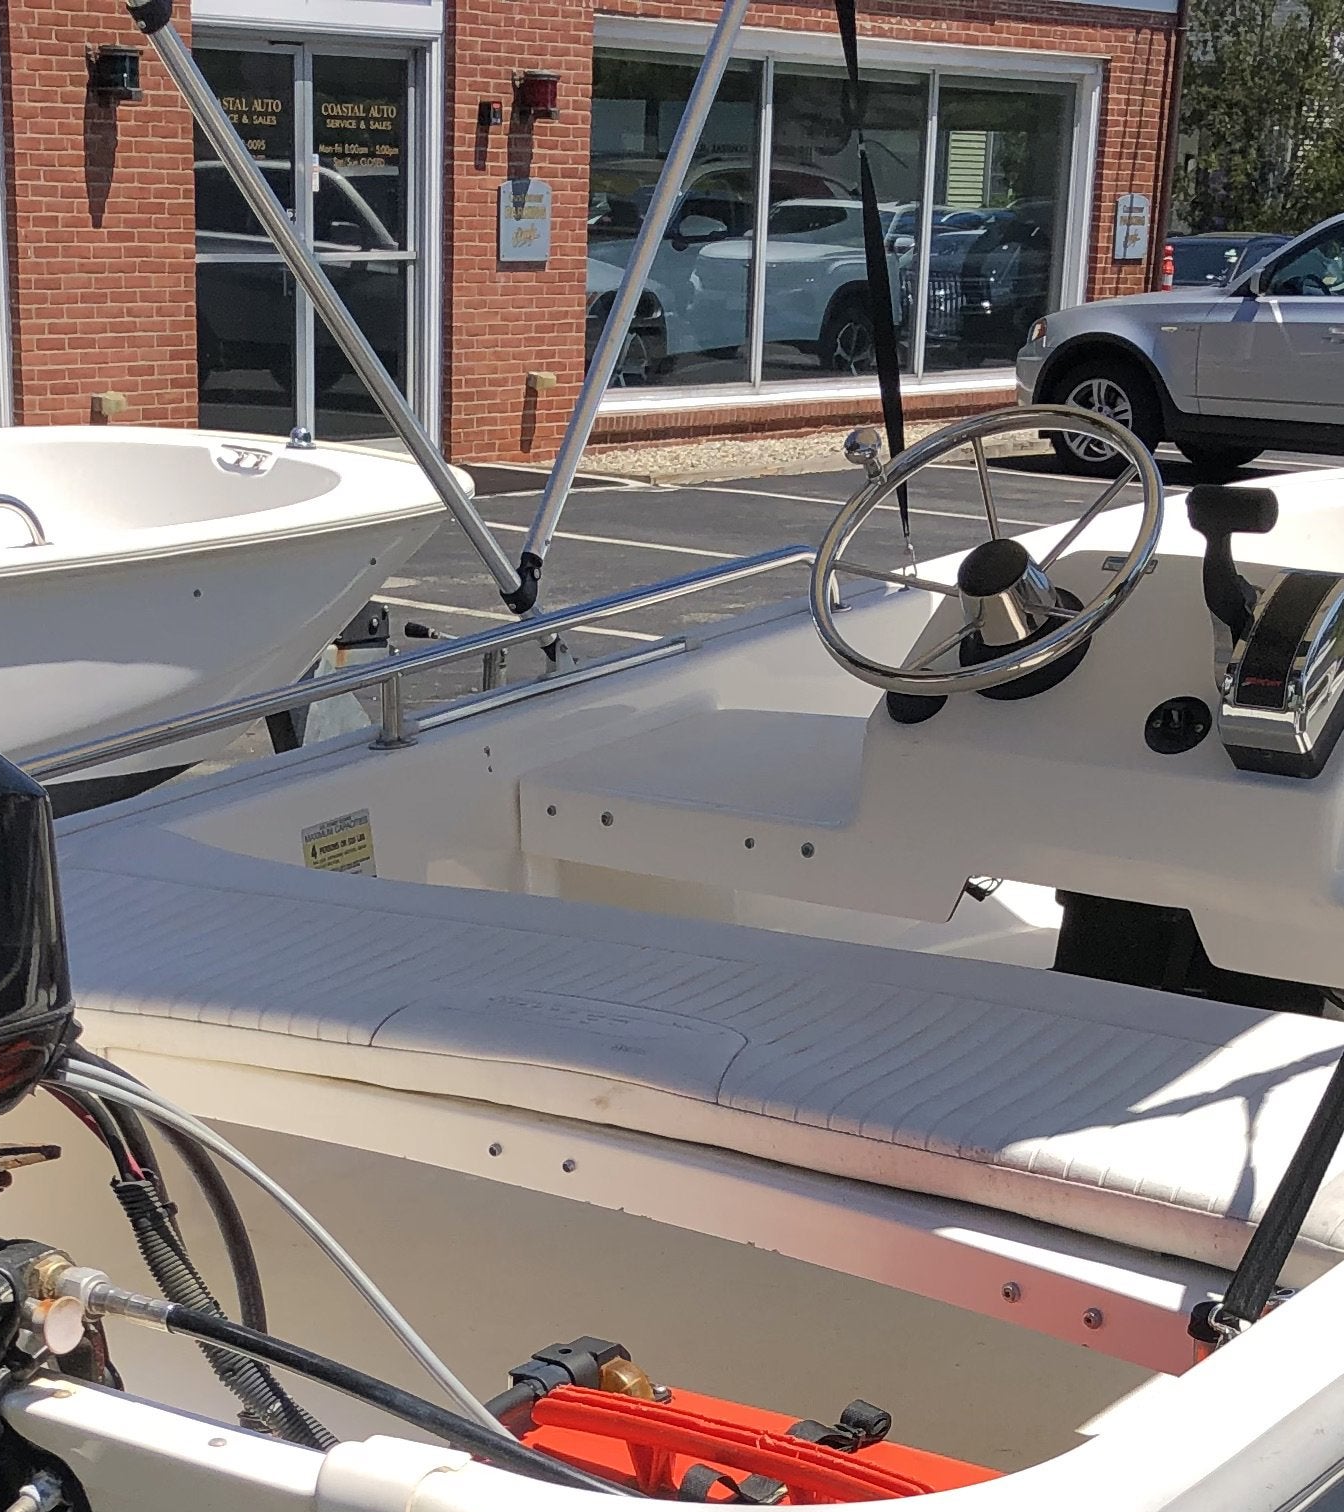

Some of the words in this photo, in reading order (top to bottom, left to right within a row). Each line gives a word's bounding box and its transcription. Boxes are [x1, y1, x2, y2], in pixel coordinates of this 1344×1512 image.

[251, 97, 282, 113] AUTO
[321, 103, 366, 117] COASTAL
[369, 105, 397, 119] AUTO
[326, 119, 357, 129] SERVICE
[369, 120, 392, 131] SALES
